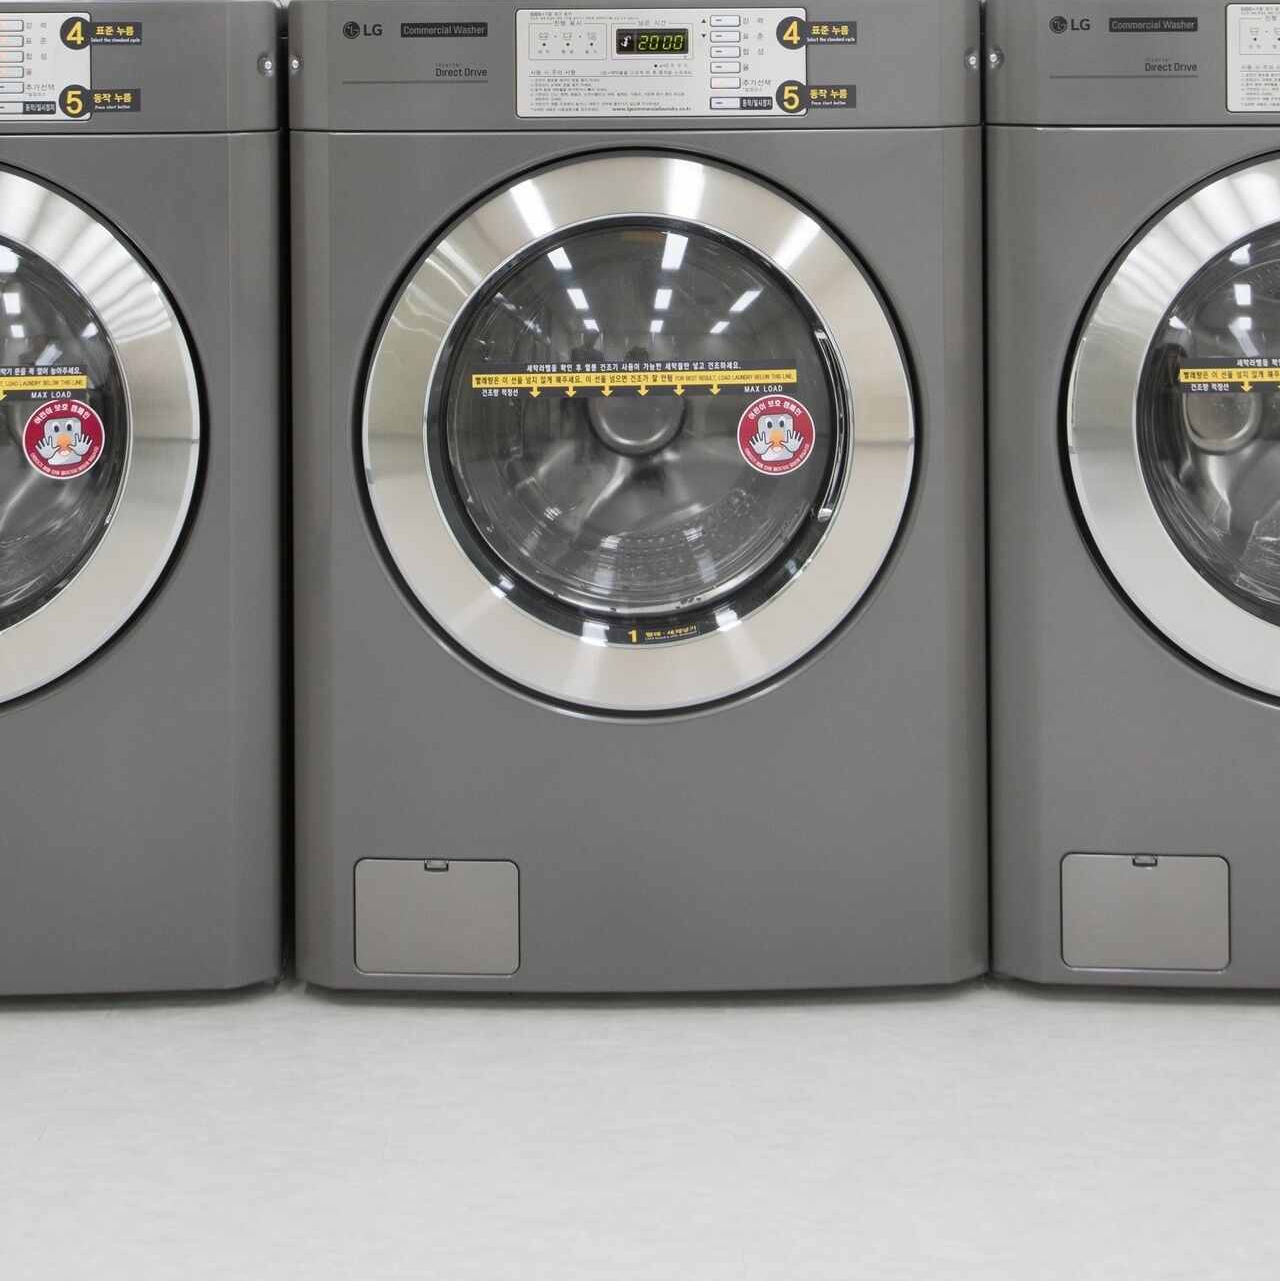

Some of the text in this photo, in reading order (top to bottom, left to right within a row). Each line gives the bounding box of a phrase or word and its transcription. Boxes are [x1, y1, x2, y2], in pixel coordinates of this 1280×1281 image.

[364, 24, 382, 37] LG
[404, 25, 486, 35] Commercial Washer
[811, 25, 850, 35] 표준 누름
[1071, 19, 1090, 31] LG
[1112, 21, 1196, 30] Commercial Washer
[66, 21, 84, 45] 4
[96, 25, 134, 37] 표준 누름
[782, 21, 800, 45] 4
[435, 67, 488, 77] Direct Drive
[1144, 63, 1198, 71] Direct Drive
[92, 93, 132, 103] 동작 누름
[783, 85, 800, 110] 5
[810, 89, 848, 99] 동작 누름
[66, 90, 82, 115] 5
[744, 385, 783, 393] MAX LOAD
[31, 391, 72, 399] MAX LOAD
[748, 399, 802, 420] 어린이 보호 캠페인
[628, 629, 638, 643] 1
